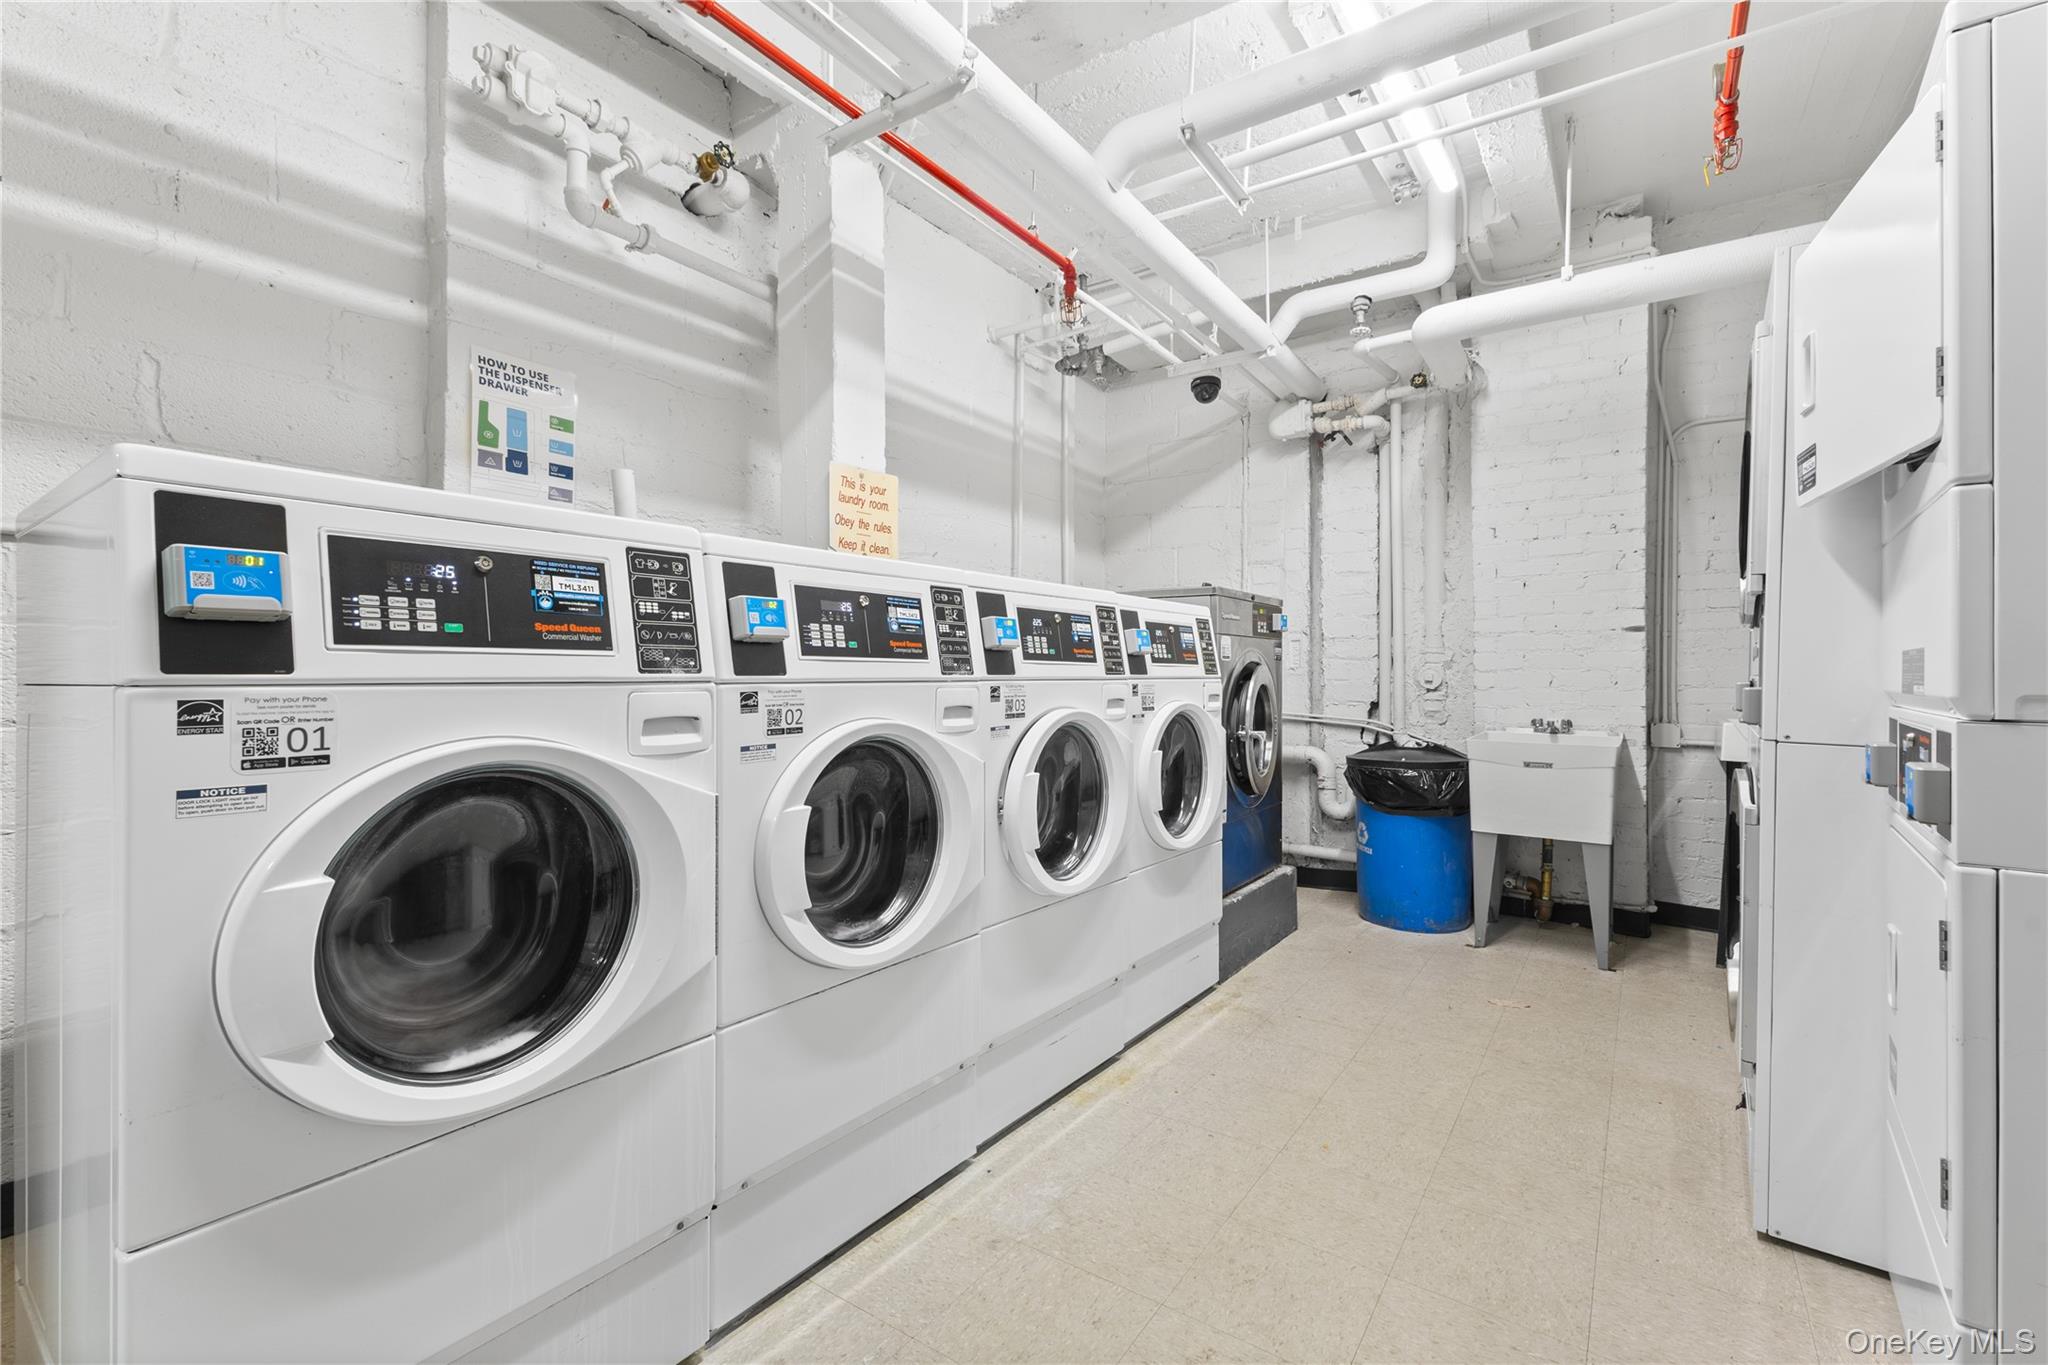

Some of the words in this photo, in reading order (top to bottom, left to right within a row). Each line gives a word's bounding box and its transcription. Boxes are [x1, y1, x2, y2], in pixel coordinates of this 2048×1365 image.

[478, 355, 507, 370] HOW
[510, 364, 525, 375] TO
[529, 370, 549, 382] USE
[478, 365, 500, 379] THE
[479, 376, 528, 397] DRAWER
[841, 475, 856, 490] This
[860, 480, 866, 492] is
[869, 485, 887, 496] your
[838, 491, 866, 509] laundry
[869, 500, 889, 512] room.
[834, 513, 855, 530] Obey
[858, 518, 870, 530] the
[873, 522, 892, 534] rules.
[838, 537, 857, 552] Keep
[861, 540, 866, 552] it
[869, 542, 890, 555] clean.
[559, 582, 595, 593] TML3411
[534, 622, 568, 633] Speed
[569, 624, 602, 634] Queen
[542, 632, 579, 640] Commercial
[580, 633, 602, 641] Washer
[1015, 699, 1025, 711] 03
[281, 716, 295, 724] OR
[785, 708, 803, 725] 02
[287, 726, 330, 752] 01
[200, 787, 246, 797] NOTICE
